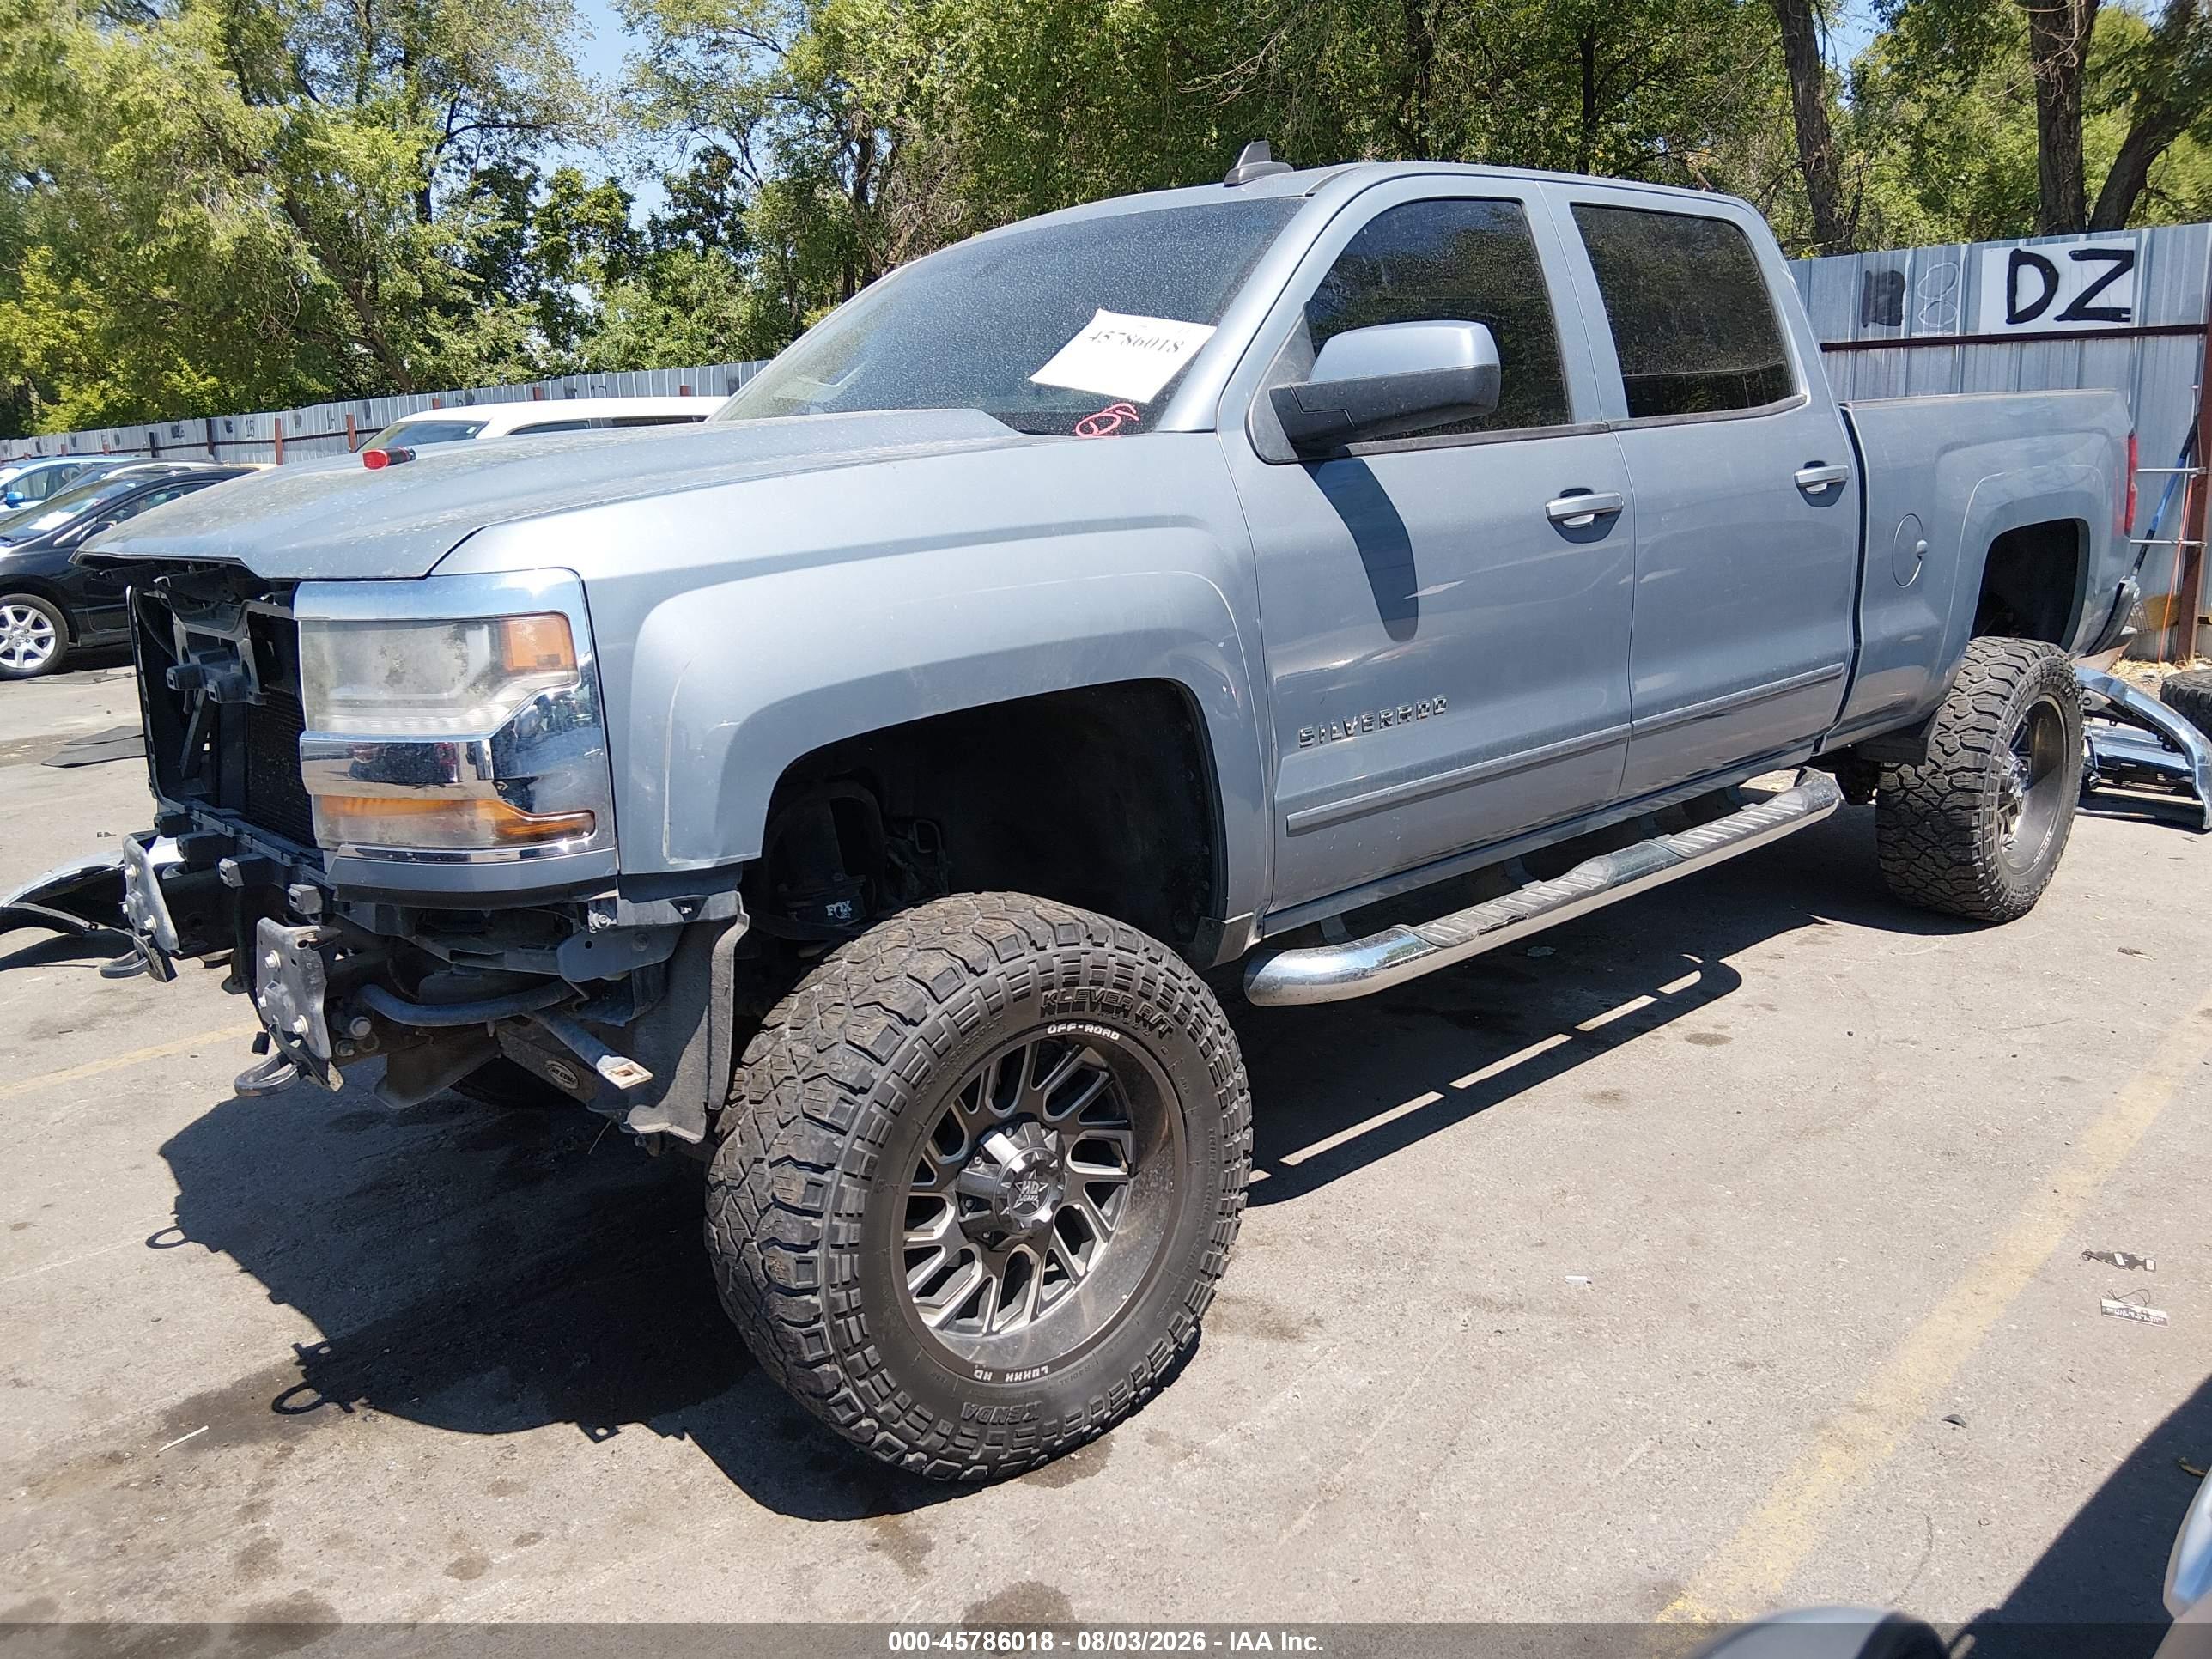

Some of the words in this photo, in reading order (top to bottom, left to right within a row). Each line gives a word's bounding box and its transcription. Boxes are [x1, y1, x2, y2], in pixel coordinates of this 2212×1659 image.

[2005, 247, 2136, 325] DZ
[1297, 694, 1449, 749] SILVERADO
[824, 900, 853, 920] FOX
[1042, 986, 1135, 1017] KLEVER
[1047, 1022, 1121, 1042] OFF-ROAD
[1020, 1180, 1040, 1194] HD
[973, 1369, 994, 1382] HD
[961, 1401, 1043, 1426] KENDA
